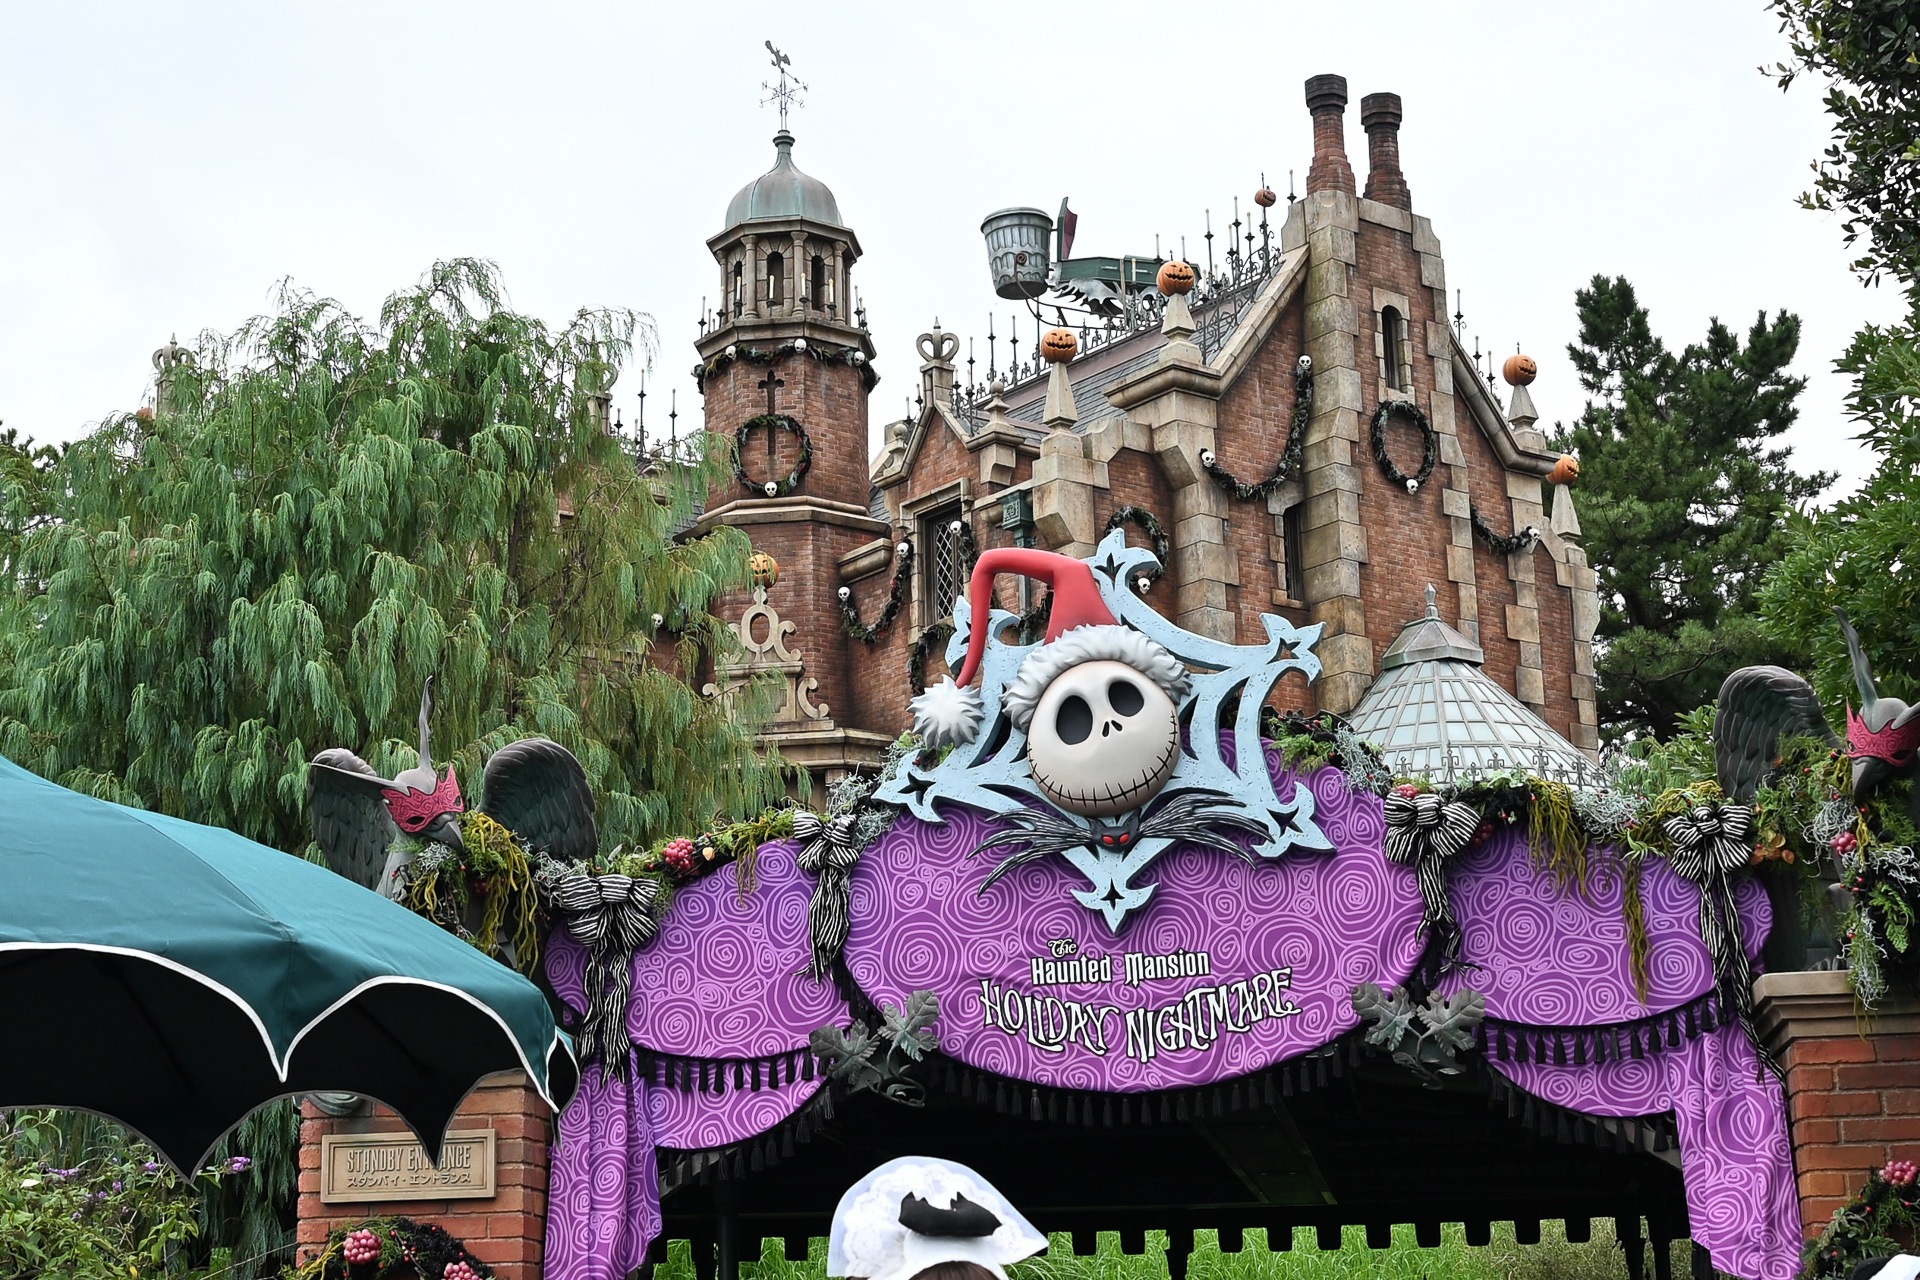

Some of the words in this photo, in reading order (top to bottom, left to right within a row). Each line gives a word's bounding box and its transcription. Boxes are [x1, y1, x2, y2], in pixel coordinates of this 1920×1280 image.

[1047, 938, 1078, 958] The
[1031, 953, 1113, 985] Haunted
[1123, 948, 1211, 988] Mansion
[979, 979, 1121, 1056] HOLIDAY
[1124, 967, 1303, 1063] NIGHTMARE
[347, 1147, 404, 1175] STANDBY
[407, 1145, 472, 1173] ENANCE
[347, 1172, 472, 1188] スタンバイ・エントランス
